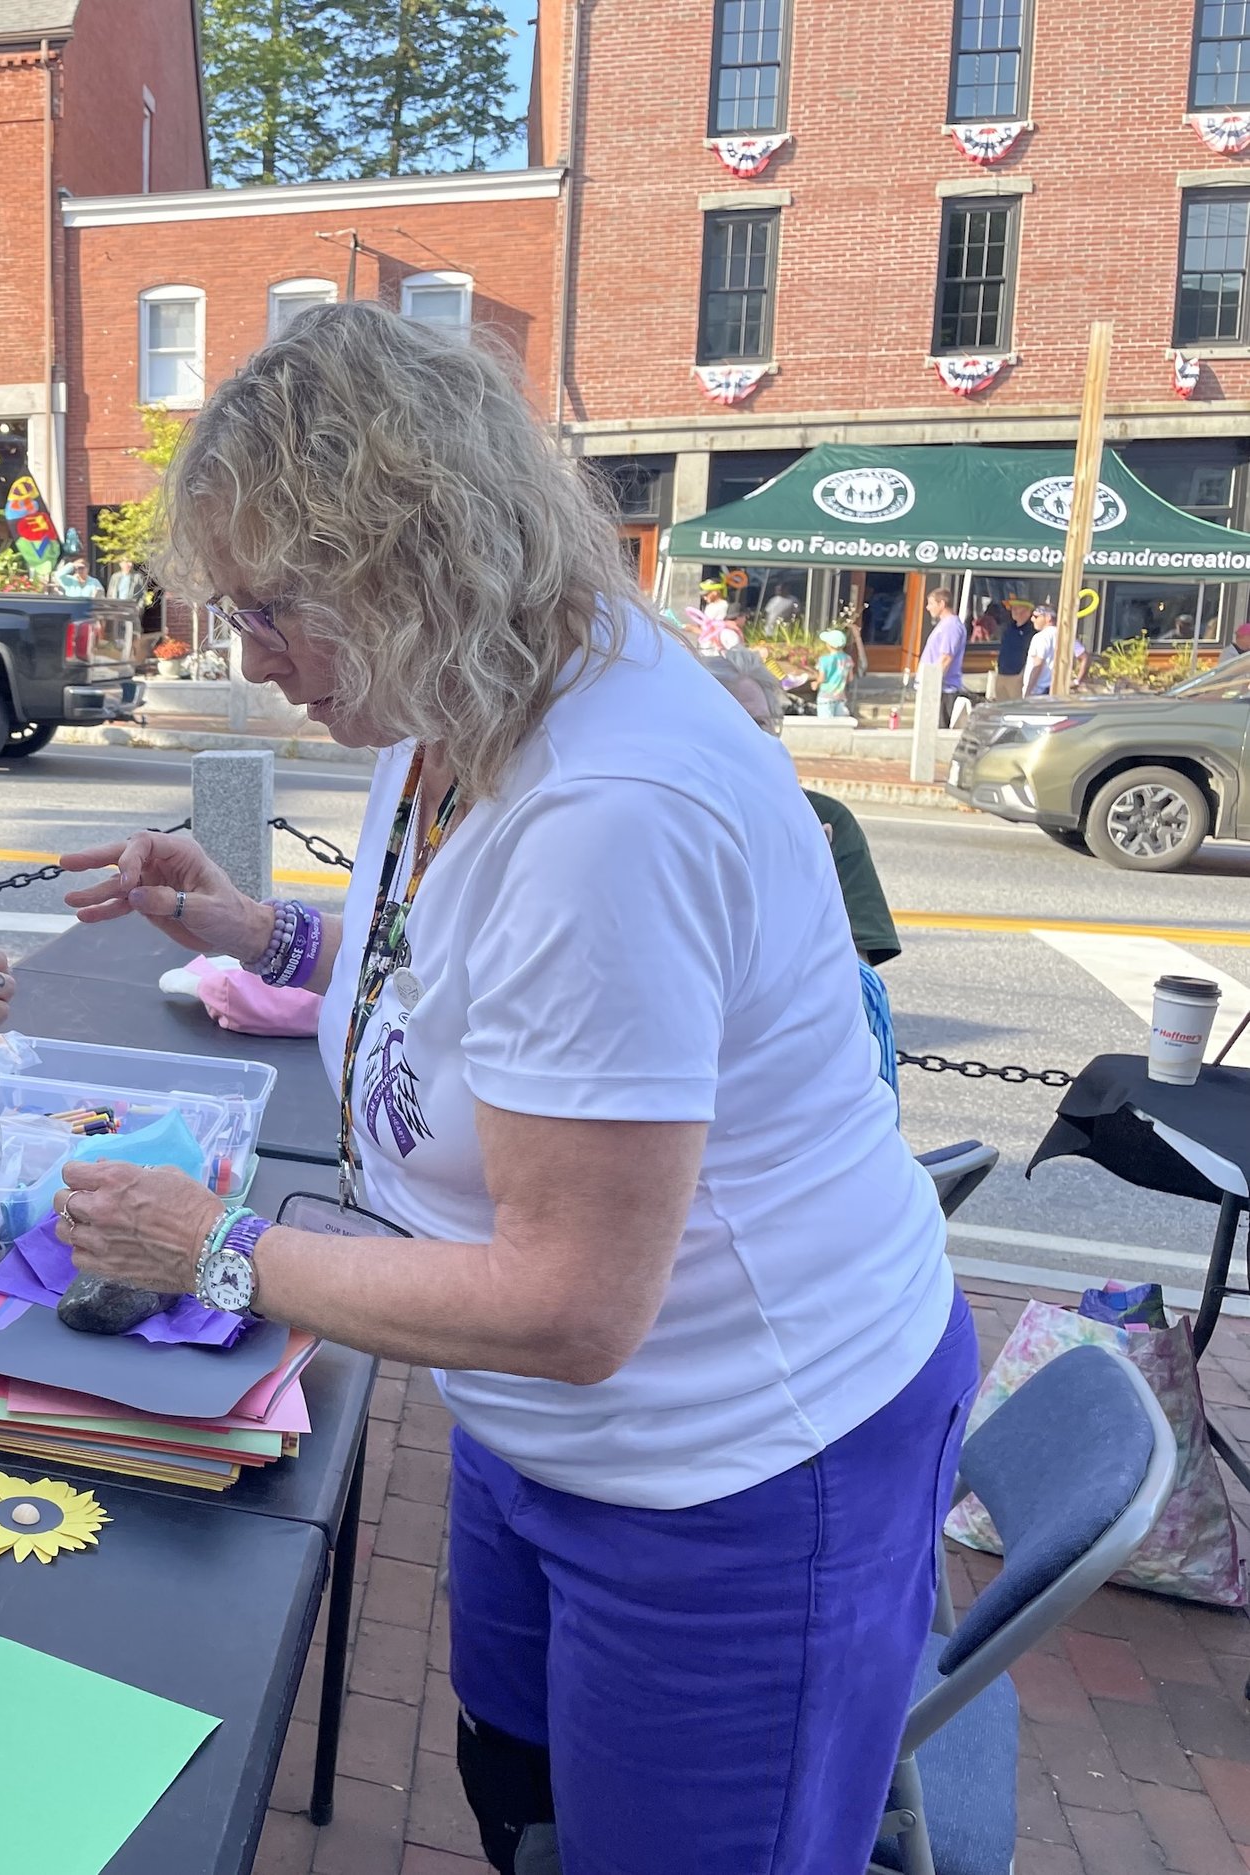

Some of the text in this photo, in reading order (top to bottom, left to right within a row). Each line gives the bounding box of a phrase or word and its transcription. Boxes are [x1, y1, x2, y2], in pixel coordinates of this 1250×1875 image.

[699, 531, 743, 550] Like
[747, 536, 773, 552] us
[777, 538, 804, 553] on
[809, 536, 912, 559] Facebook
[915, 540, 939, 563] @
[374, 1066, 399, 1101] SHARIN
